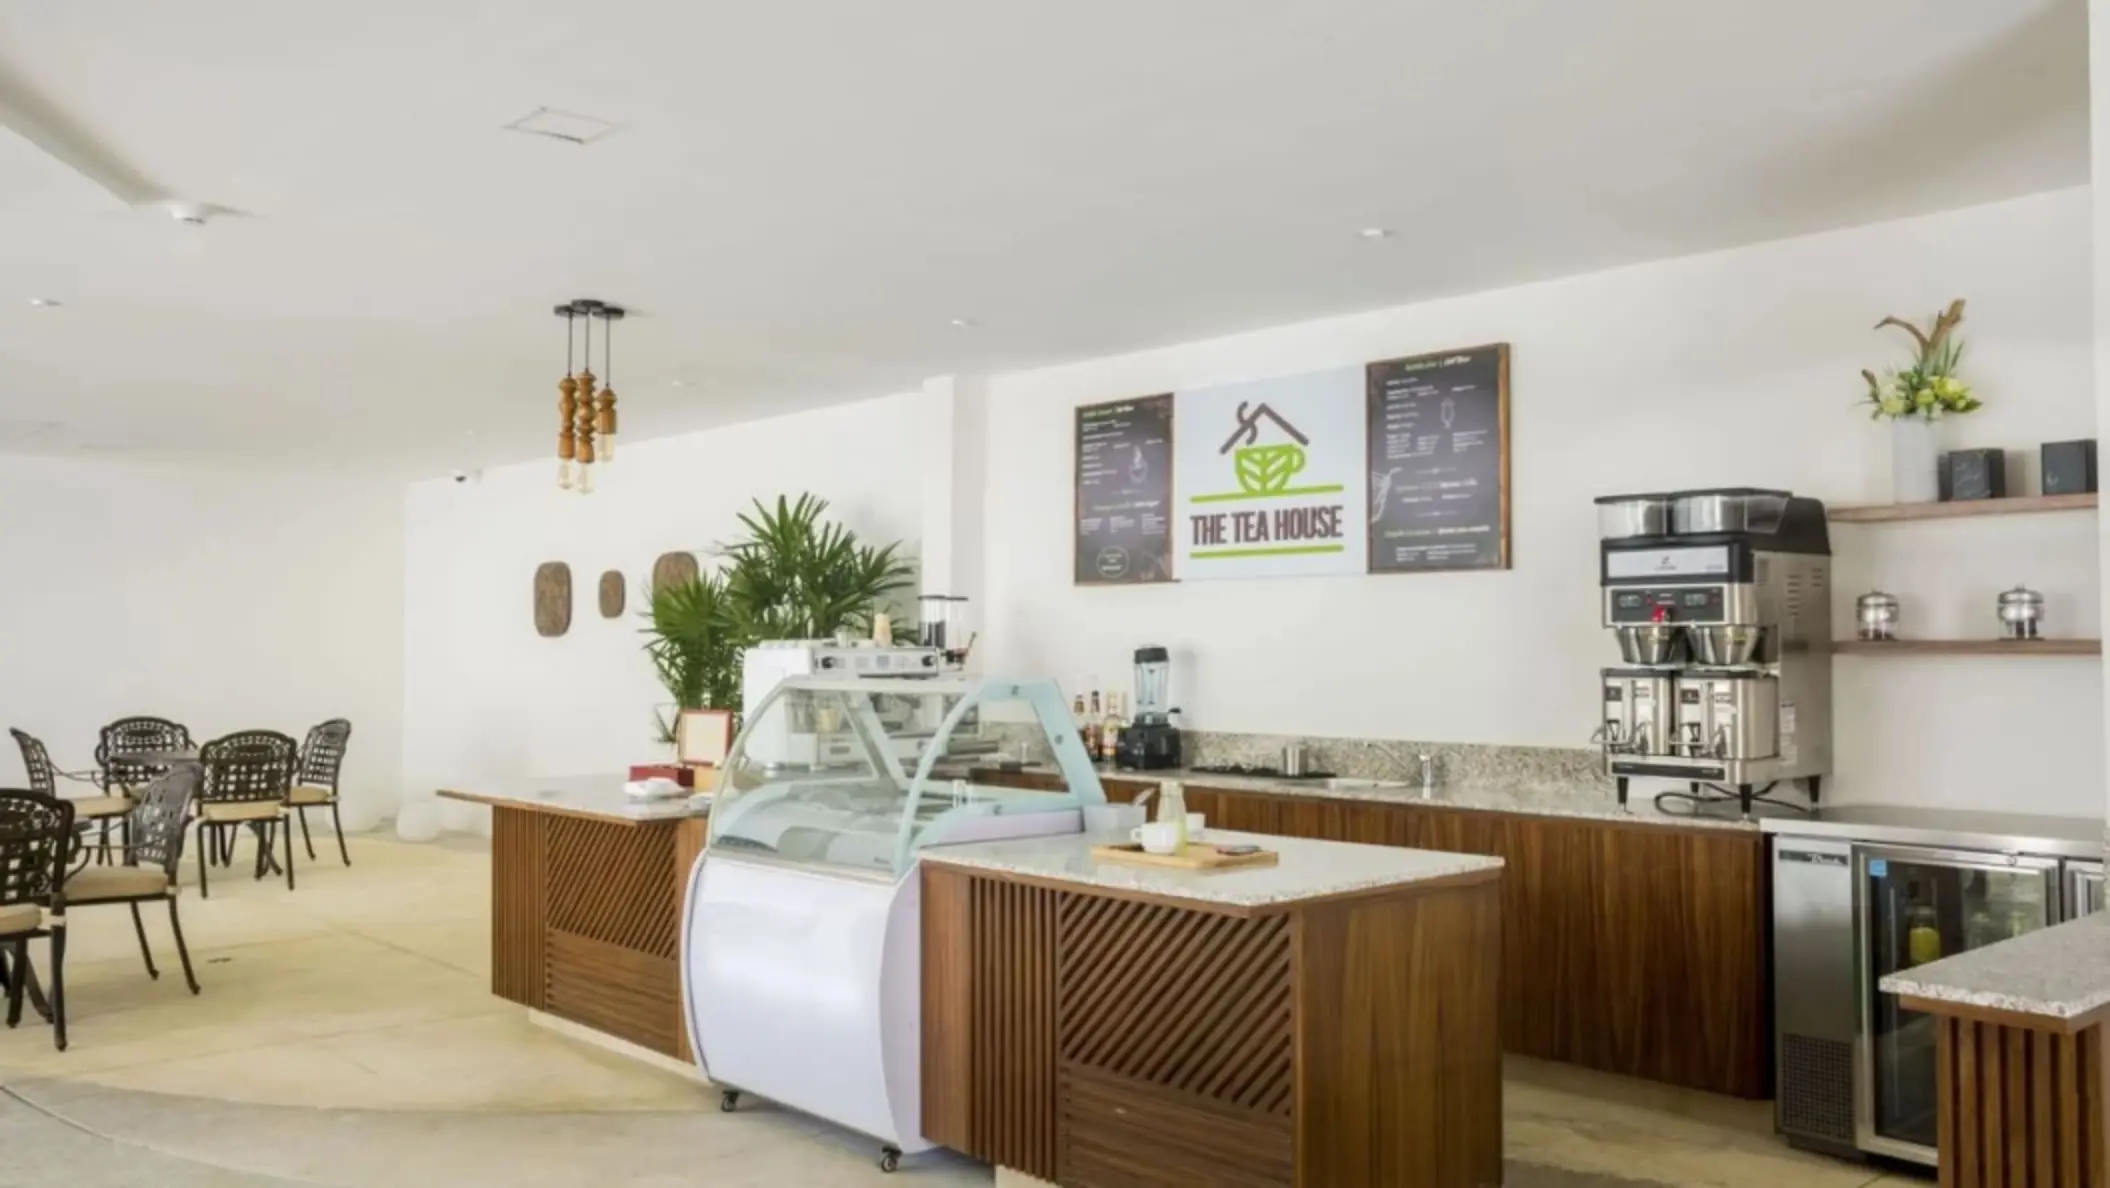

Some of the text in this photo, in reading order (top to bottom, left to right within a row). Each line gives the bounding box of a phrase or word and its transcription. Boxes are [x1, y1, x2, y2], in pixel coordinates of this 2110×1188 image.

[1190, 514, 1227, 545] THE
[1231, 511, 1269, 543] TEA
[1274, 505, 1344, 540] HOUSE
